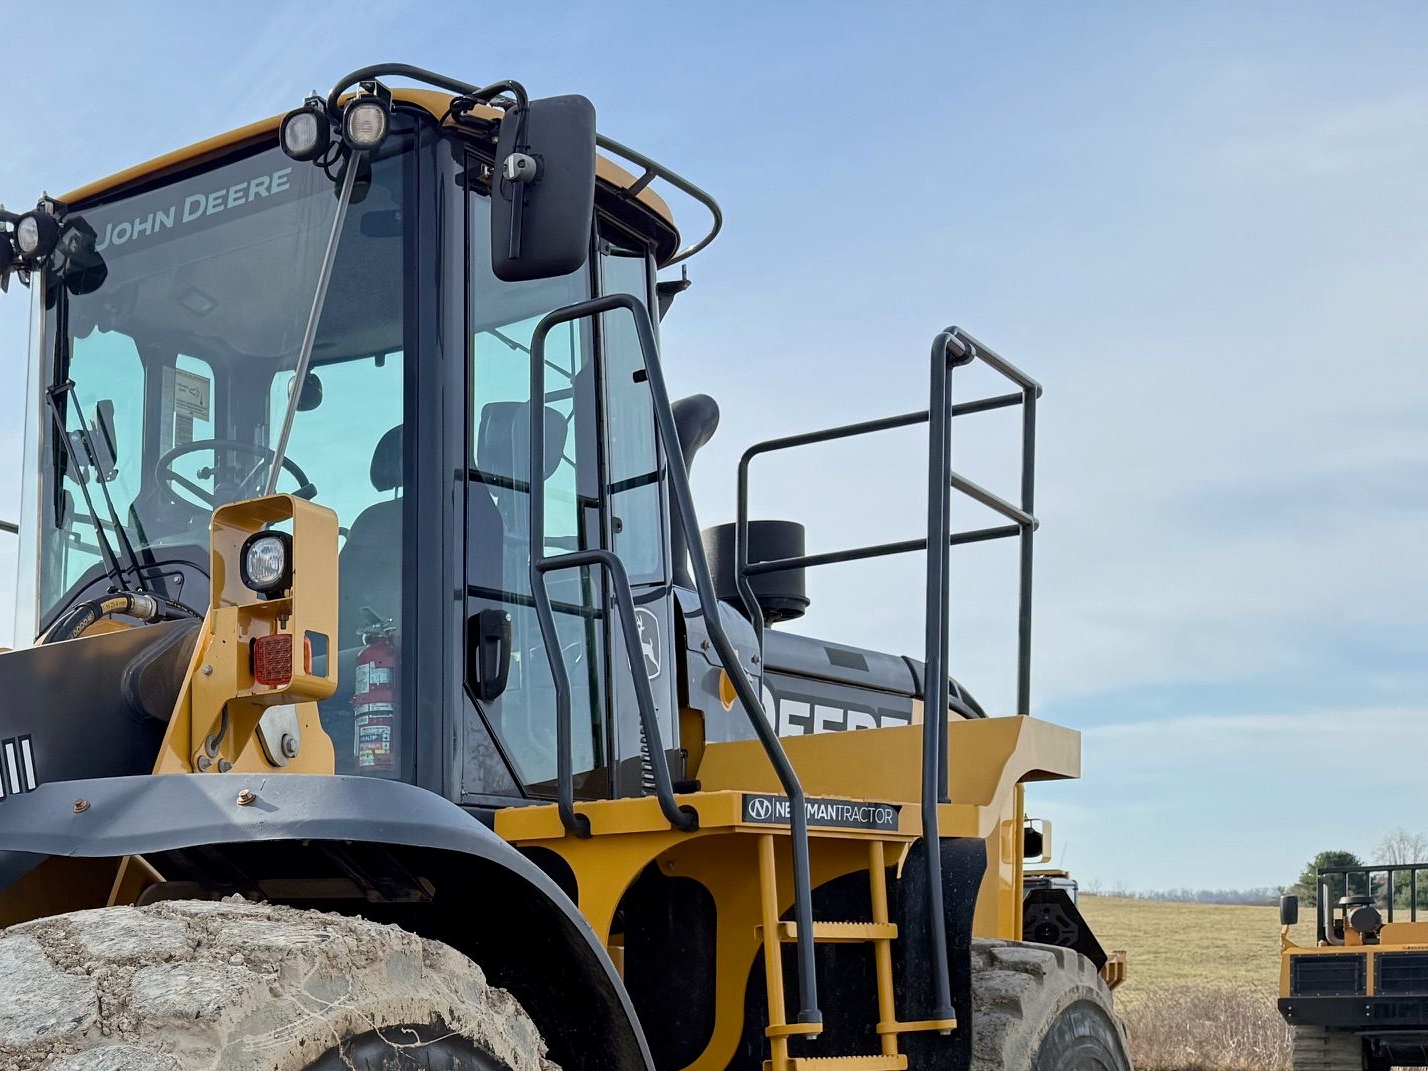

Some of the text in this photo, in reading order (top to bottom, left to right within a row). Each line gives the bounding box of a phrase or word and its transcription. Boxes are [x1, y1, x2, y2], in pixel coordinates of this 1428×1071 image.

[95, 168, 292, 251] JOHN DEERE
[776, 802, 892, 824] NEMANTRACTOR
